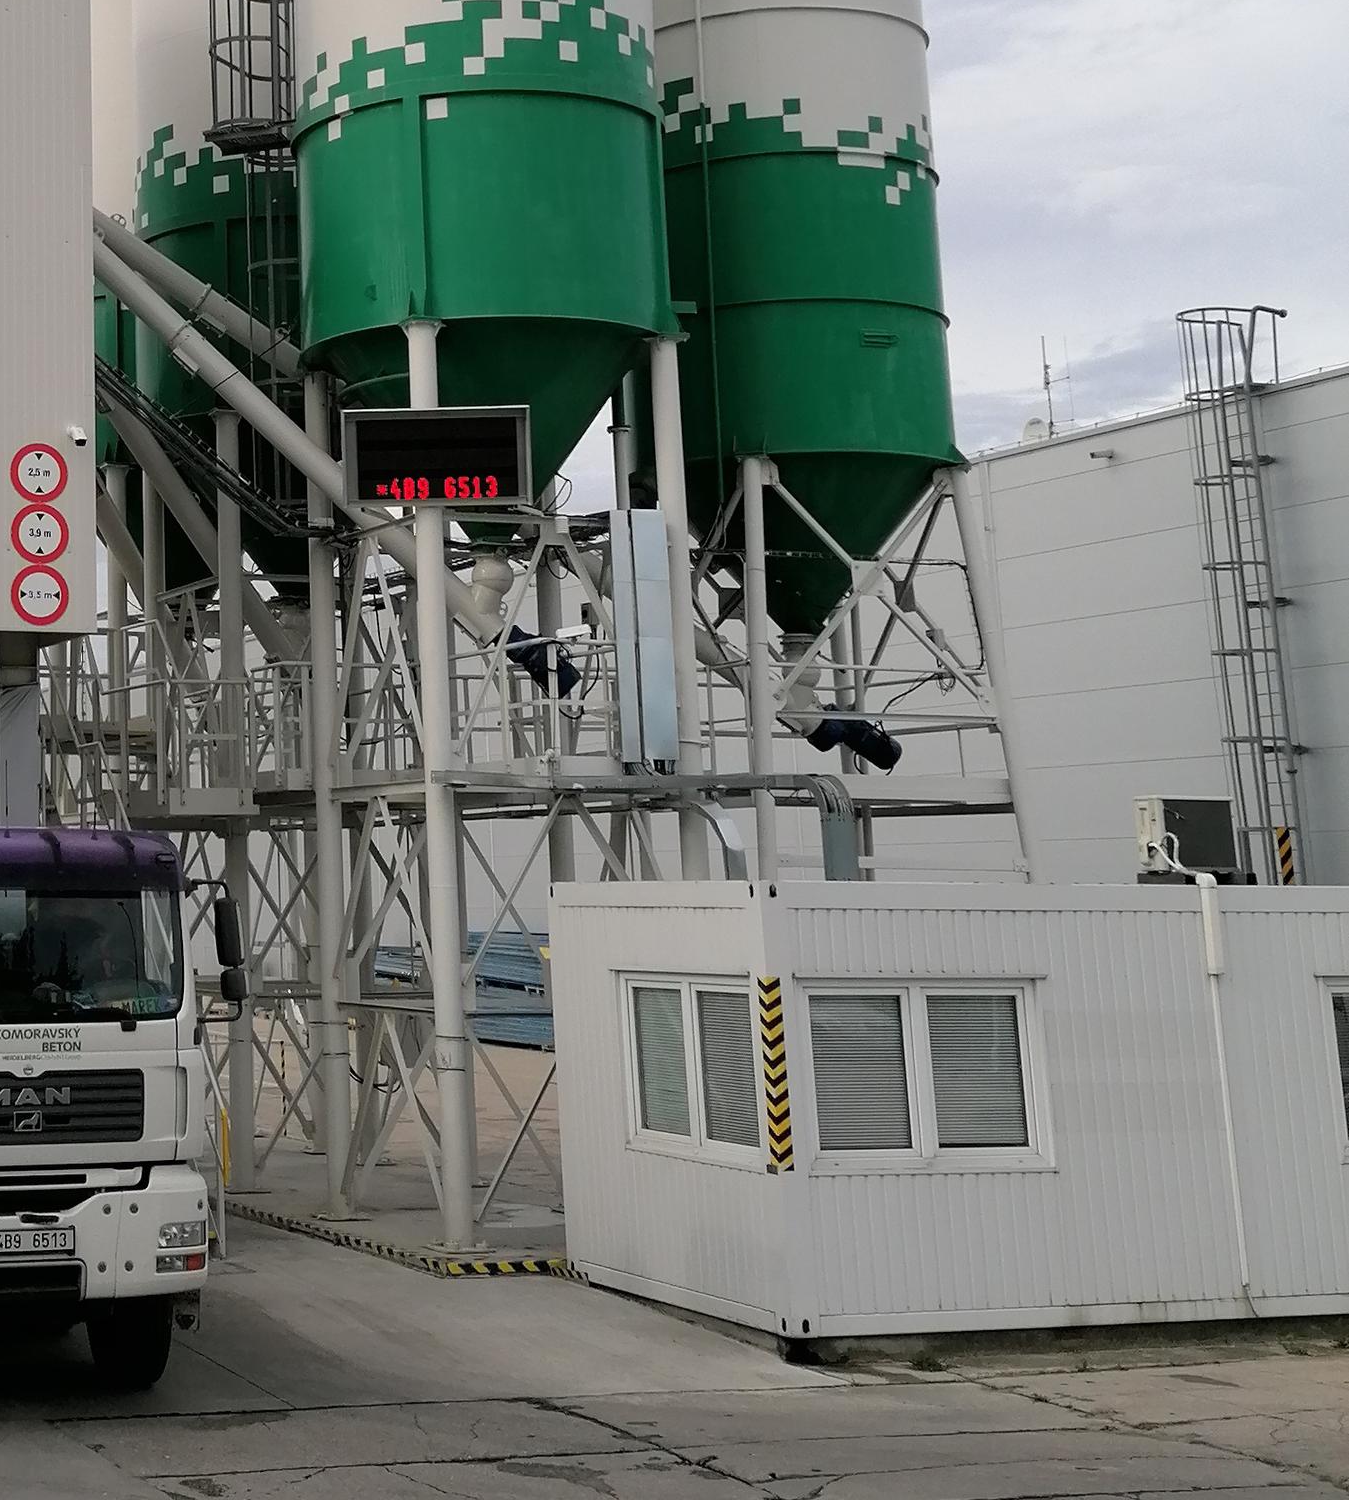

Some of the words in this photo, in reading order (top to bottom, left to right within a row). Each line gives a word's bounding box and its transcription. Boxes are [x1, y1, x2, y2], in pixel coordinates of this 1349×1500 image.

[444, 475, 498, 499] 6513
[42, 1041, 81, 1052] BETON
[33, 1233, 67, 1248] 6513
